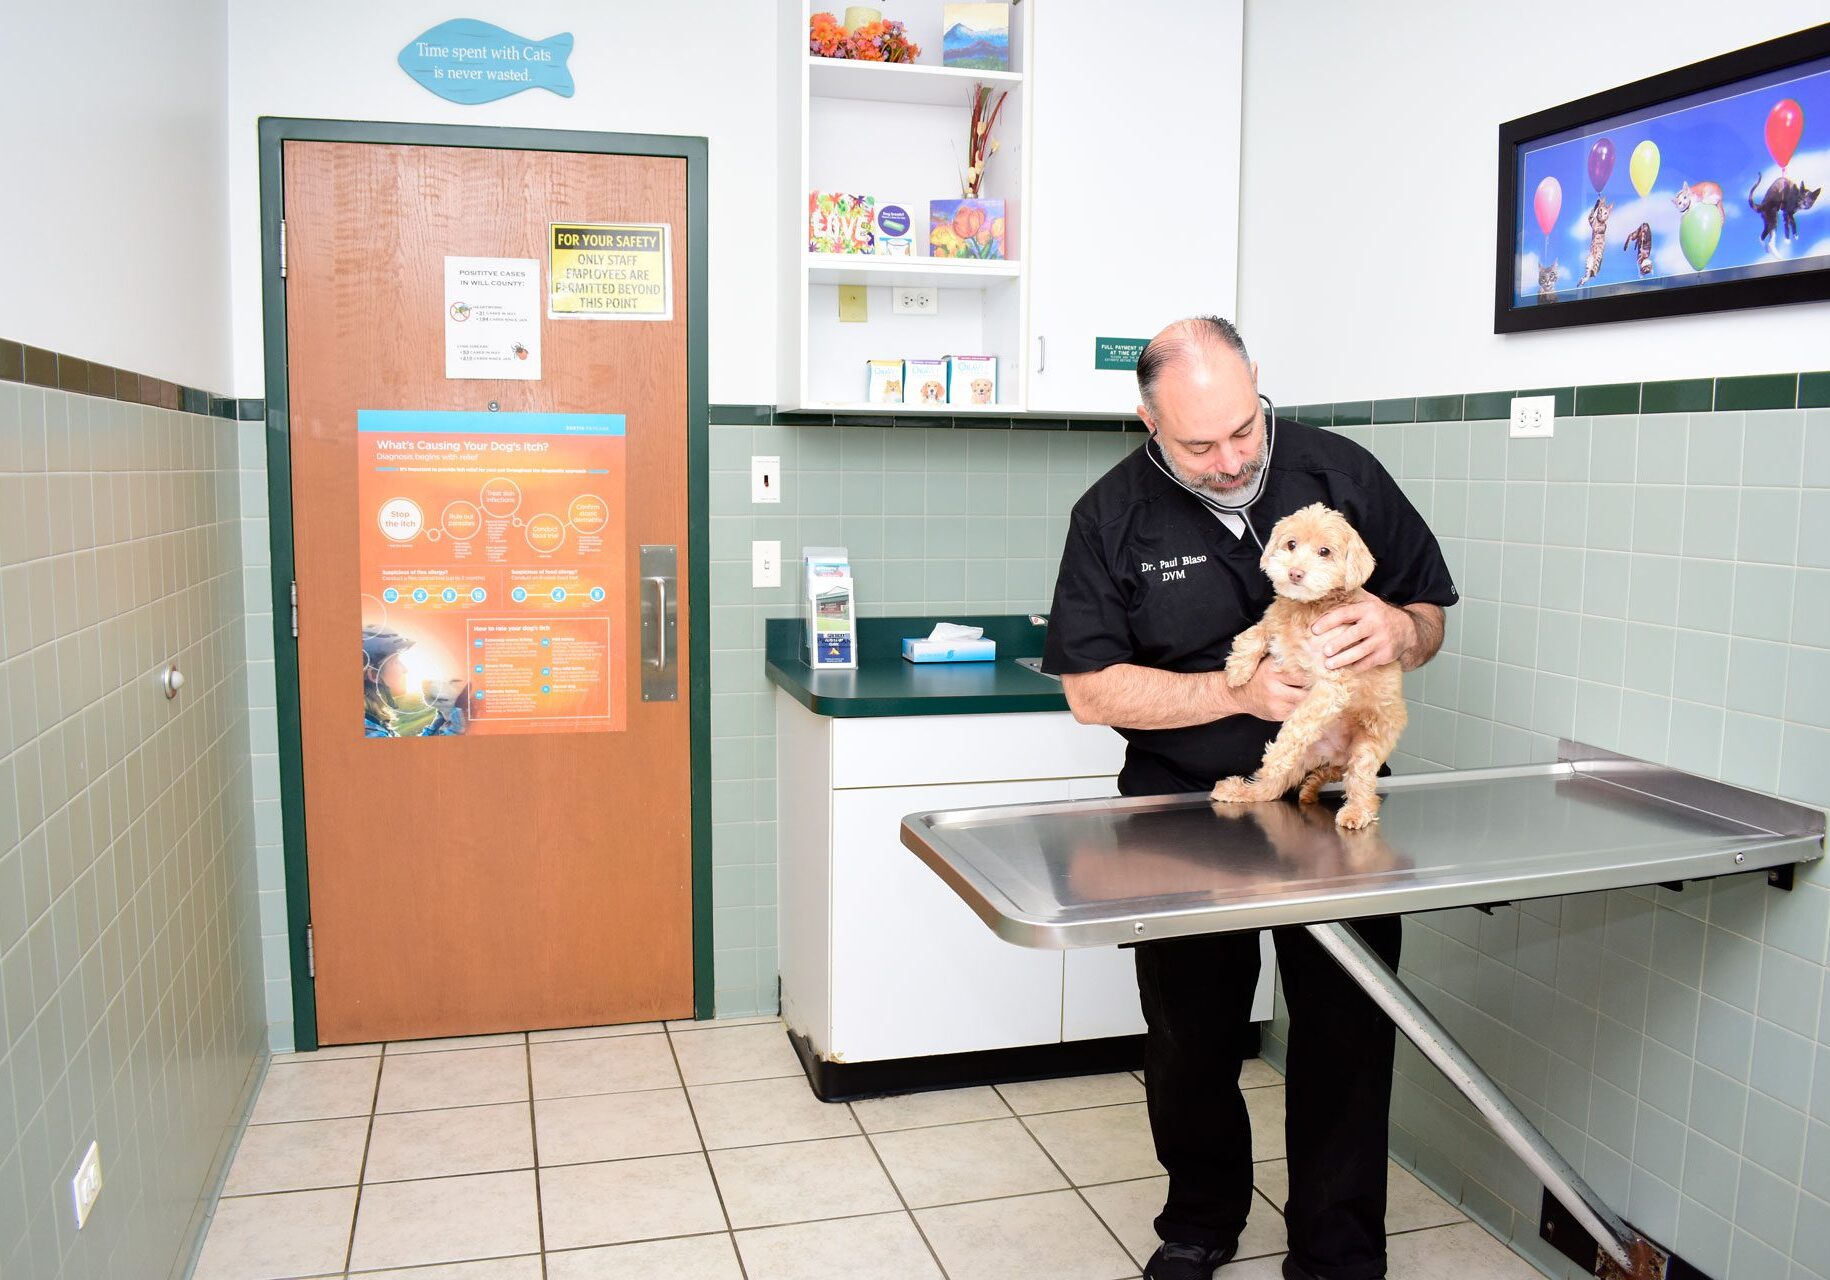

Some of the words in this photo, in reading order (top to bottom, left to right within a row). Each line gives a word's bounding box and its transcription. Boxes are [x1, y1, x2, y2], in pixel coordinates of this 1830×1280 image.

[416, 42, 449, 58] Time
[451, 46, 487, 61] spent
[491, 47, 519, 61] with
[523, 47, 551, 61] Cats
[434, 66, 444, 79] is
[448, 68, 482, 80] never
[486, 69, 532, 82] wasted.
[558, 233, 579, 246] FOR
[582, 234, 613, 247] YOUR
[617, 234, 657, 248] SAFETY
[578, 253, 605, 266] ONLY
[607, 254, 638, 267] STAFF
[565, 268, 627, 280] EMPLOYEES
[629, 269, 649, 281] ARE
[618, 283, 661, 296] BEYOND
[580, 297, 603, 309] THIS
[606, 297, 638, 309] POINT
[376, 440, 415, 451] What's
[417, 441, 461, 453] Causing
[463, 442, 488, 451] Your
[491, 441, 521, 454] Dog's
[523, 442, 549, 453] Itch?
[376, 453, 413, 462] Diagnosis
[414, 454, 443, 462] begins
[460, 453, 480, 461] relief
[391, 511, 410, 519] Stop
[385, 520, 399, 528] the
[400, 520, 416, 528] itch
[1141, 562, 1156, 572] Dr.
[1160, 557, 1178, 569] Paul
[1182, 555, 1207, 566] Blaso
[1162, 570, 1186, 581] DVM
